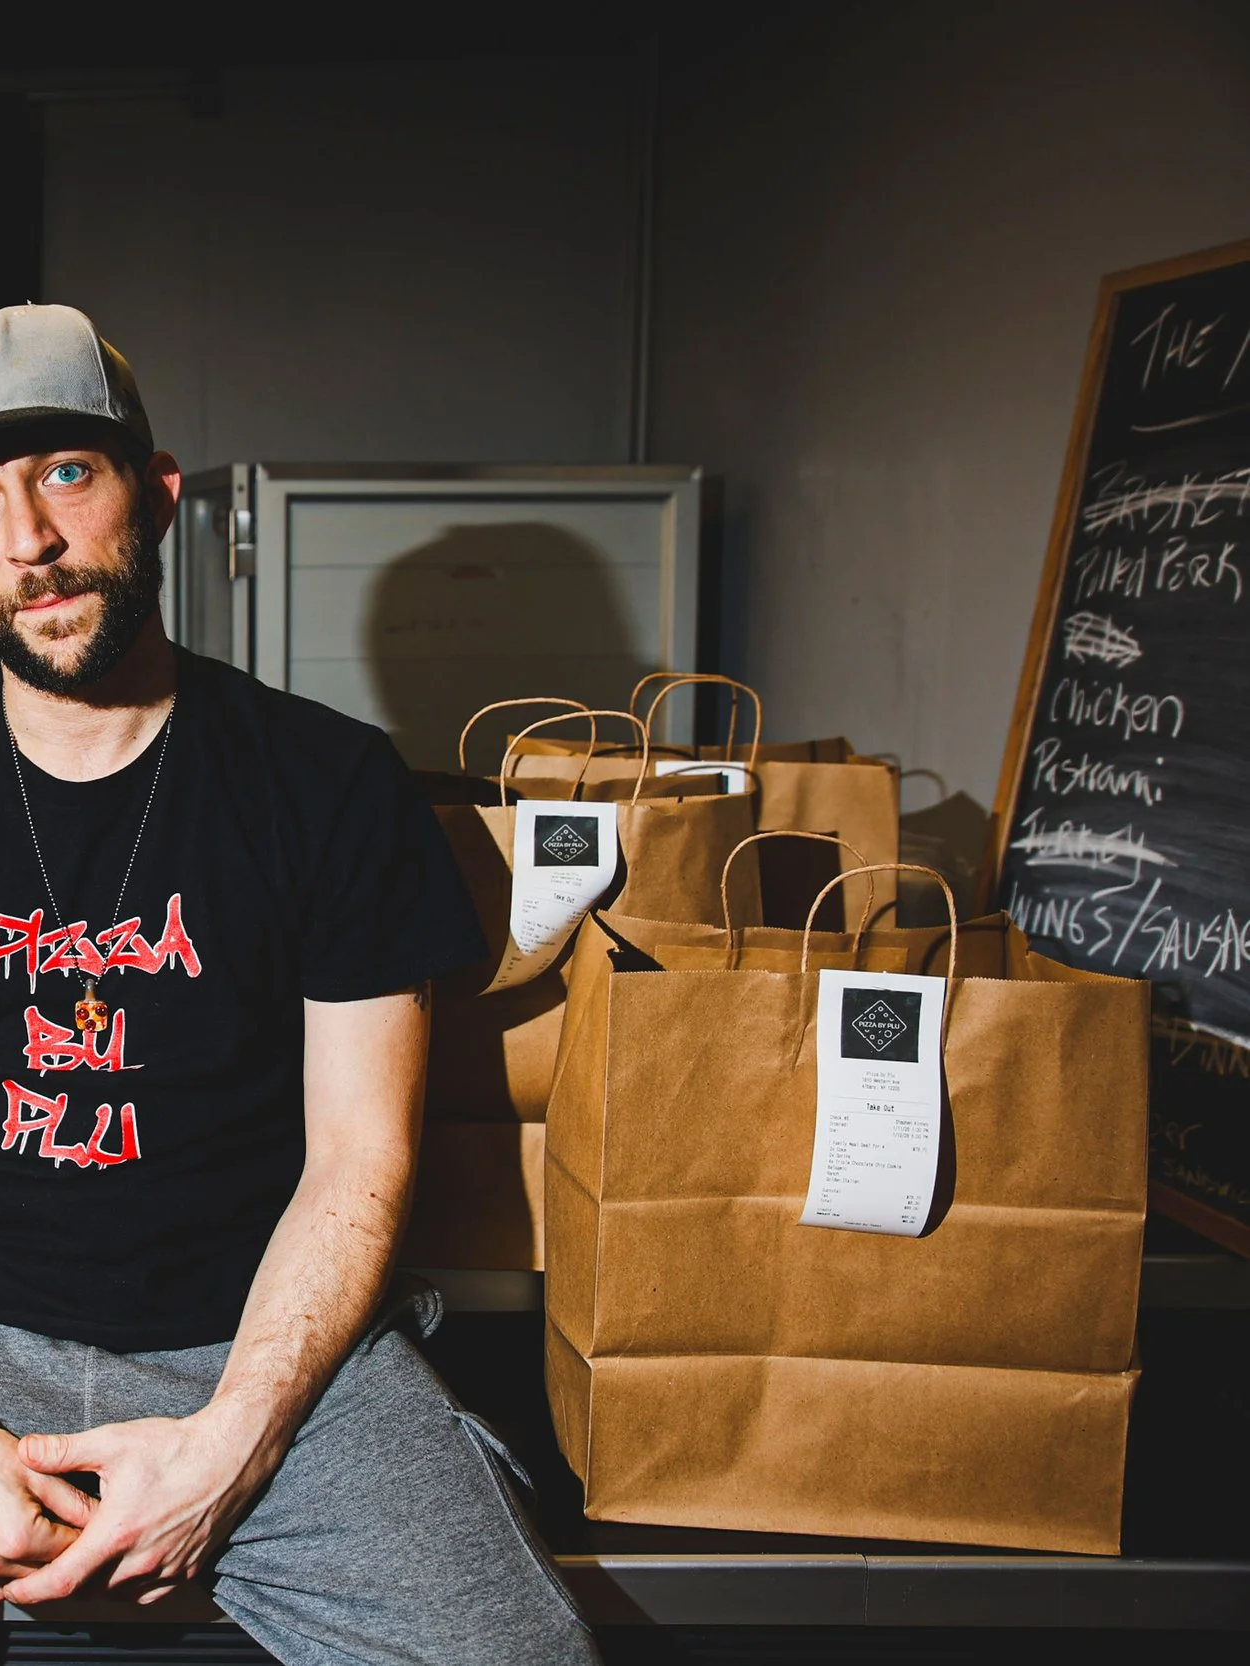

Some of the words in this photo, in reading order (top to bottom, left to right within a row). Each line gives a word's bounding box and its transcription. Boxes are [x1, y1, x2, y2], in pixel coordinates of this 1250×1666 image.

[1130, 303, 1225, 390] THE
[1051, 678, 1184, 741] Chicken
[1033, 736, 1163, 807] Pastrami
[858, 1021, 877, 1029] PIZZA
[1, 1079, 141, 1169] PLU
[866, 1103, 881, 1112] Take
[883, 1104, 895, 1113] Out
